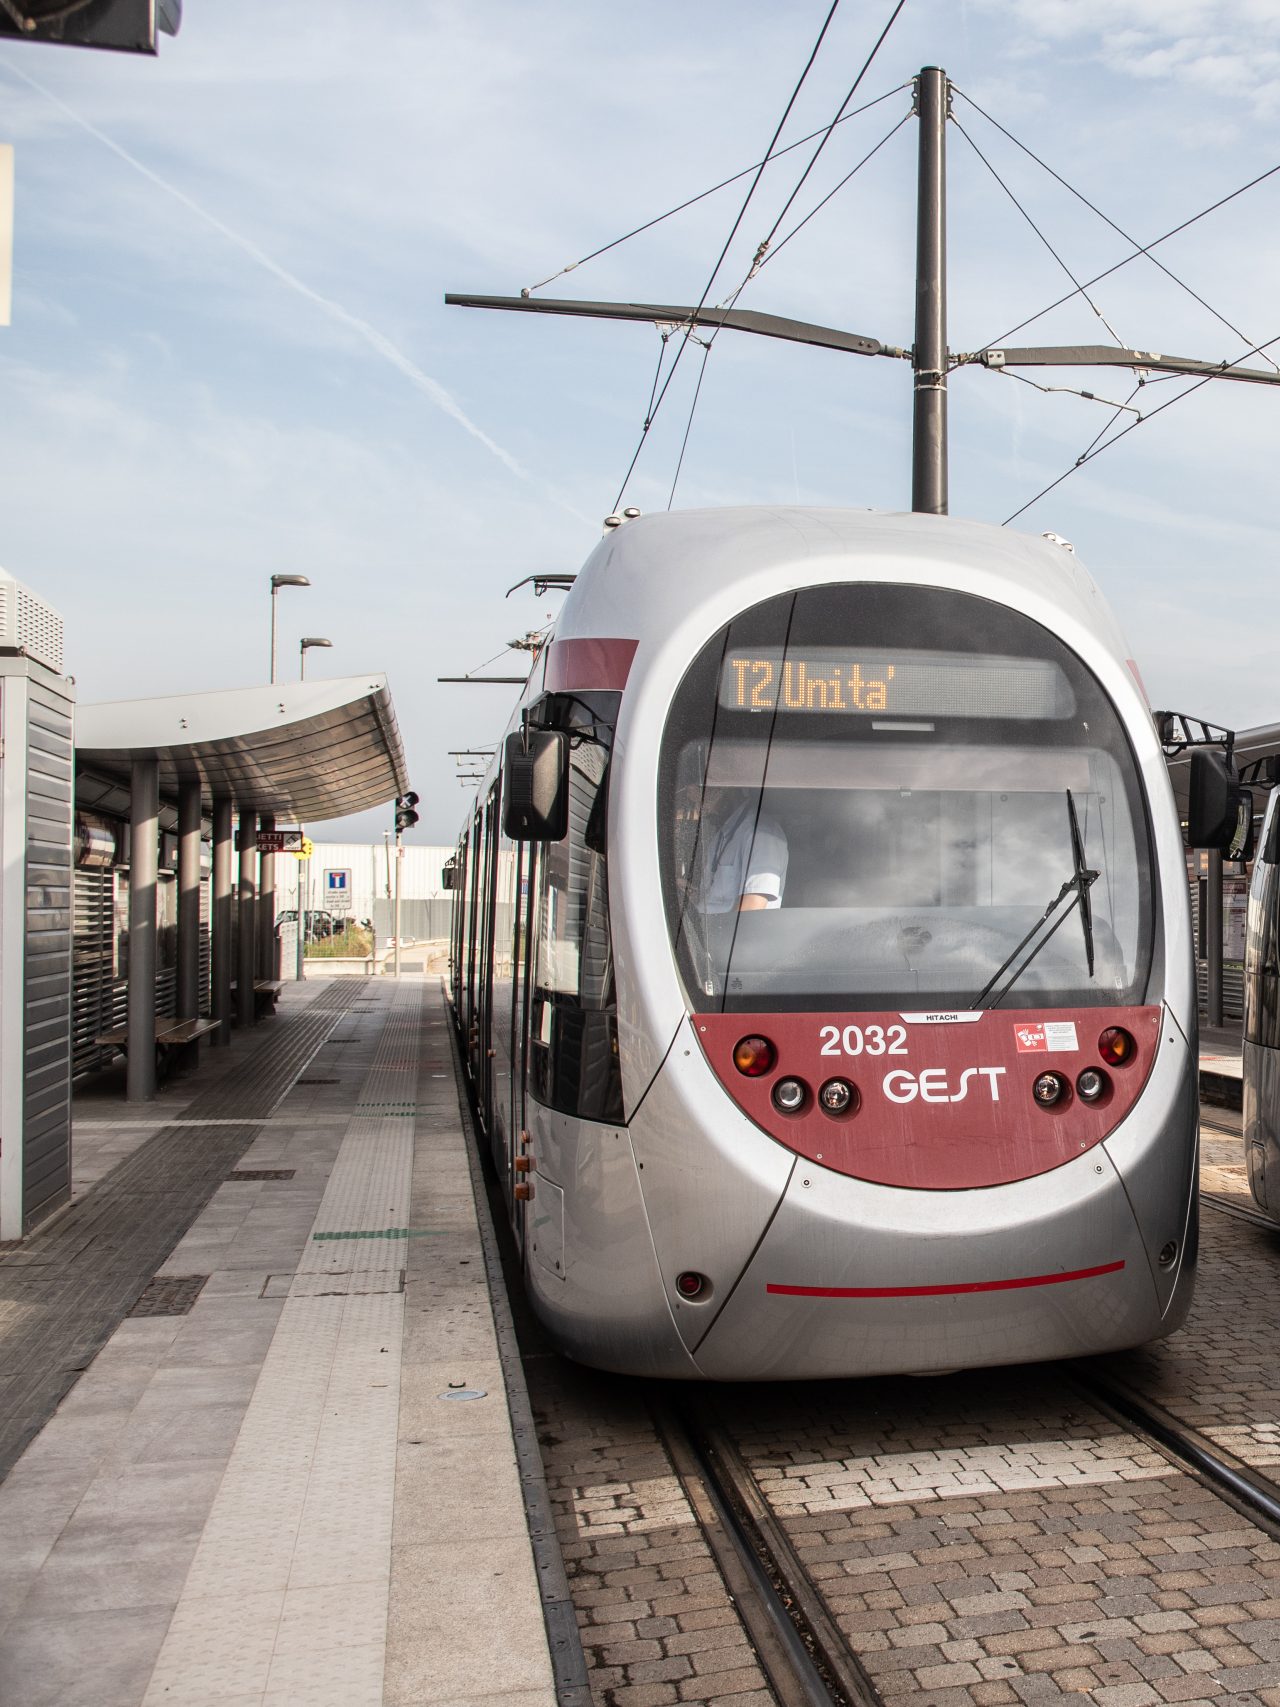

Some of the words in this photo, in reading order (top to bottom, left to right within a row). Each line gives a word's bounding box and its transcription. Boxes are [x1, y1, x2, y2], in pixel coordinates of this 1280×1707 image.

[732, 660, 772, 706] T2
[785, 662, 895, 709] Unita'
[819, 1025, 908, 1056] 2032
[882, 1067, 1006, 1103] GEST
